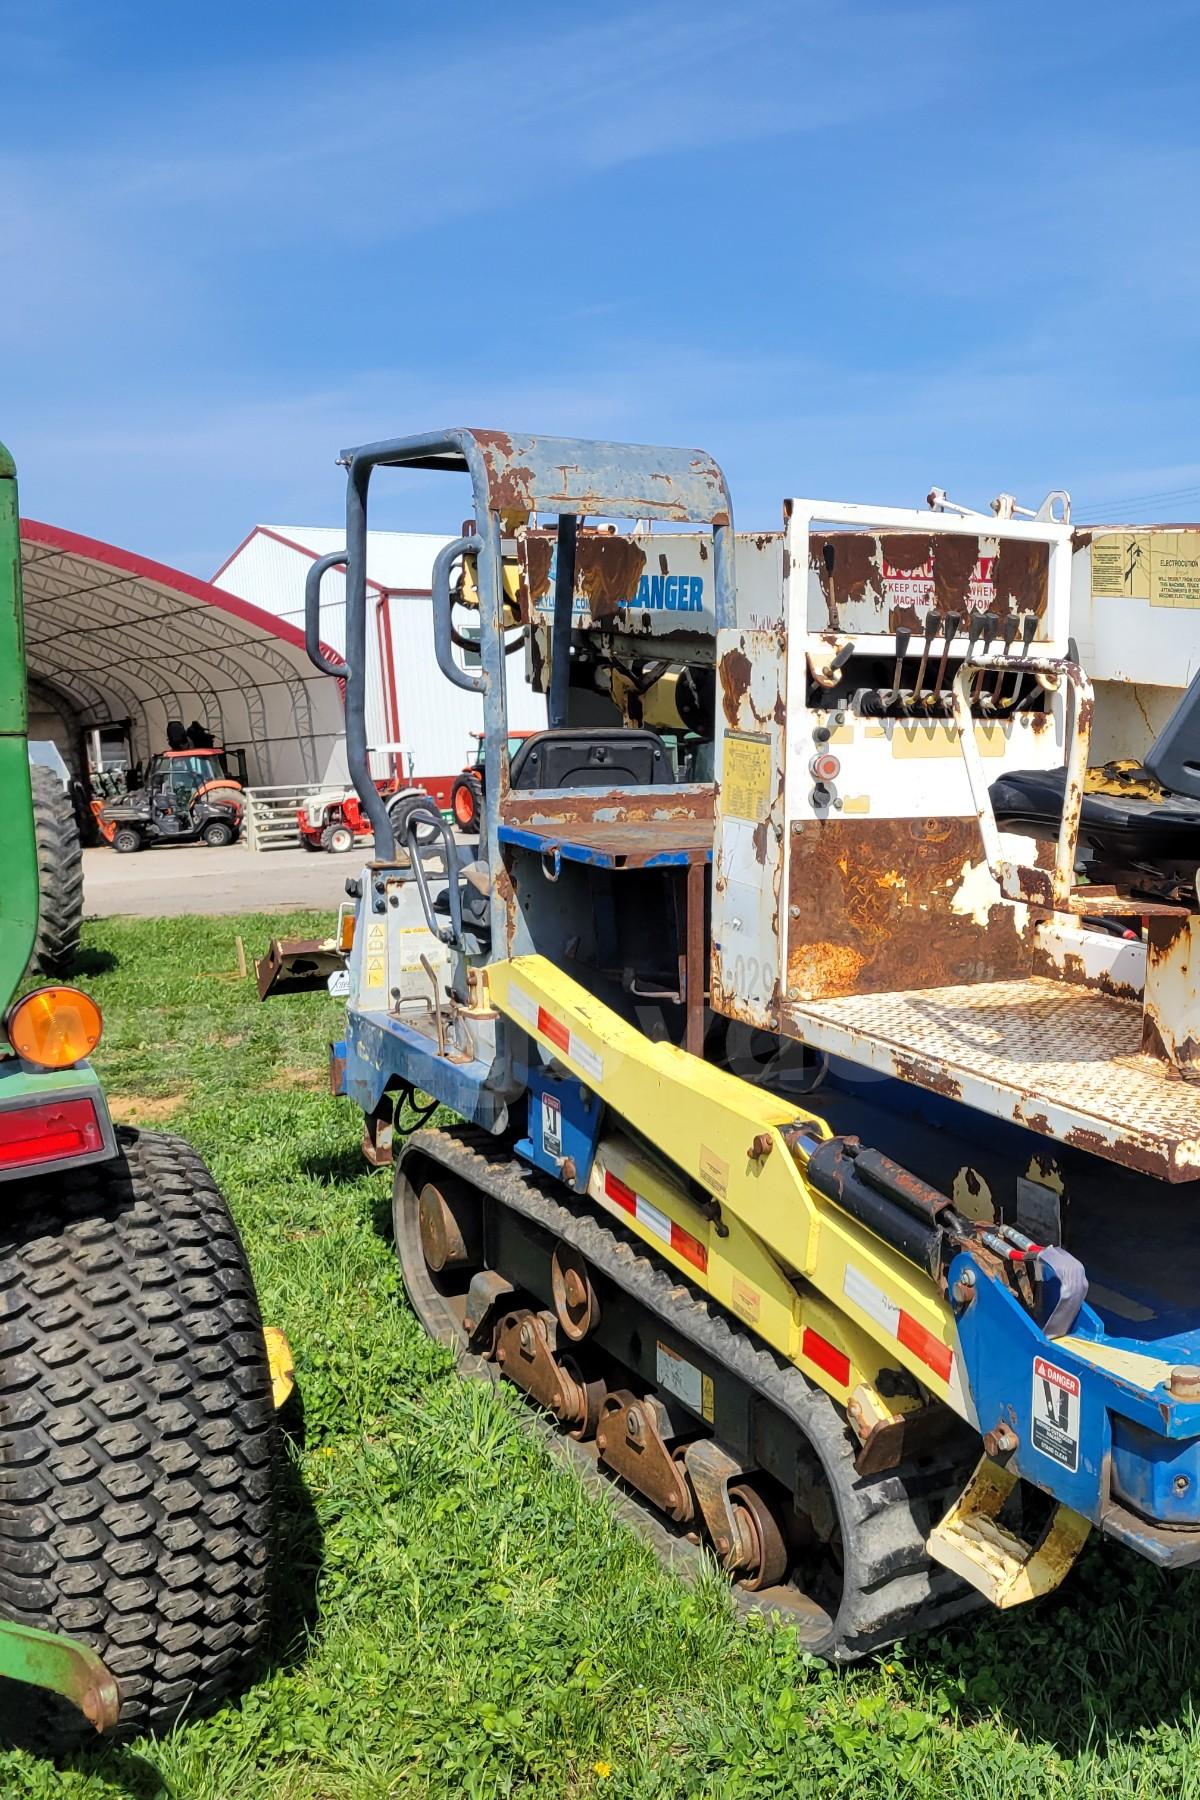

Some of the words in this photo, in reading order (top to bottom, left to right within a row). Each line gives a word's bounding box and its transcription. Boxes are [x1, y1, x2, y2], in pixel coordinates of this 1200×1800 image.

[626, 574, 704, 612] ANGER
[888, 583, 910, 593] KEEP
[912, 584, 935, 594] CLEA
[1047, 1367, 1076, 1391] DANGER
